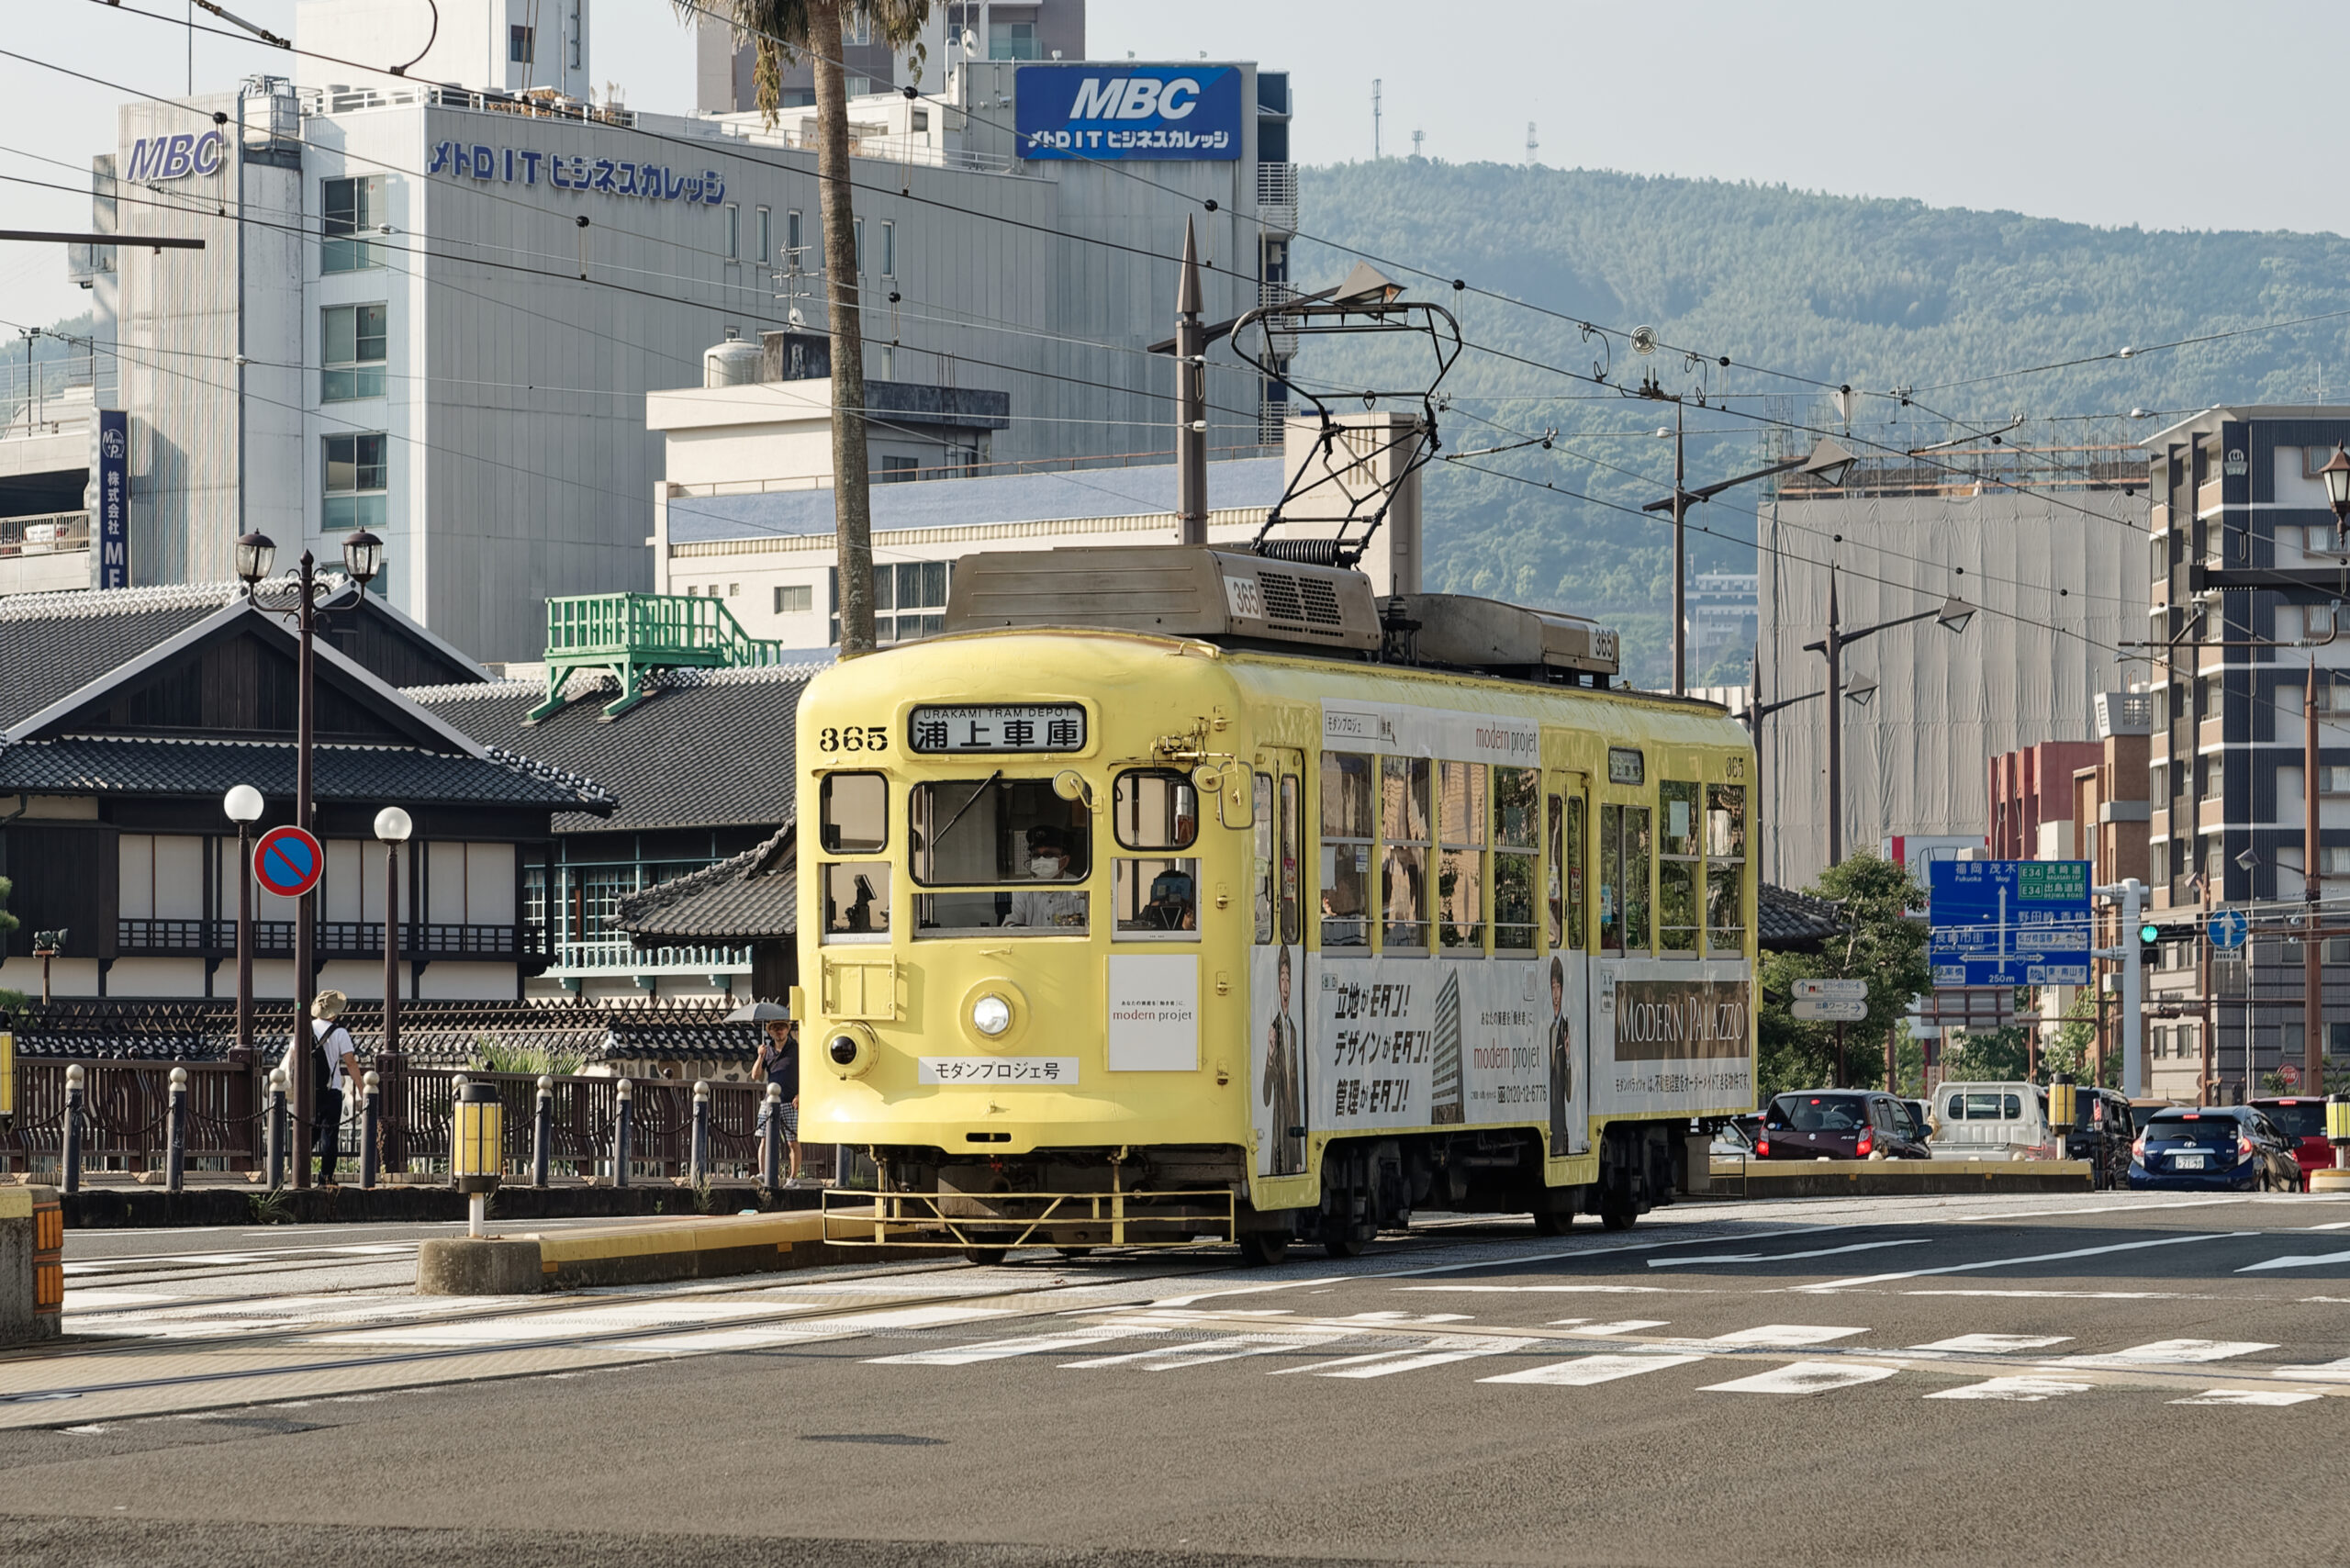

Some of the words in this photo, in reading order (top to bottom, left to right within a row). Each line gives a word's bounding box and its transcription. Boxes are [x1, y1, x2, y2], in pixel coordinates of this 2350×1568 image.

[1069, 77, 1200, 119] MBC
[127, 130, 224, 181] MBC
[107, 470, 120, 536] 株式会社
[1234, 580, 1259, 616] 365
[1595, 628, 1613, 658] 365
[923, 709, 981, 719] URAKAMI
[987, 708, 1023, 718] TRAM
[1028, 707, 1071, 718] DEPOT
[820, 725, 889, 752] 365
[917, 719, 1079, 749] 浦上車庫
[1475, 721, 1509, 751] modern
[1511, 724, 1537, 758] projet
[1726, 756, 1744, 778] 365
[1955, 862, 1983, 875] 福岡
[1989, 863, 2016, 874] 茂木
[2021, 868, 2041, 878] E34
[2021, 886, 2041, 895] E34
[2043, 883, 2084, 893] 出島道路
[1988, 974, 2015, 983] 250m
[1113, 1009, 1156, 1020] modern
[1158, 1009, 1192, 1022] projet
[1619, 996, 1684, 1043] MODERN
[1689, 996, 1744, 1042] PALAZZO
[935, 1060, 1060, 1080] モダンプロジェ号
[1474, 1037, 1510, 1070] modern
[1513, 1037, 1540, 1076] projet
